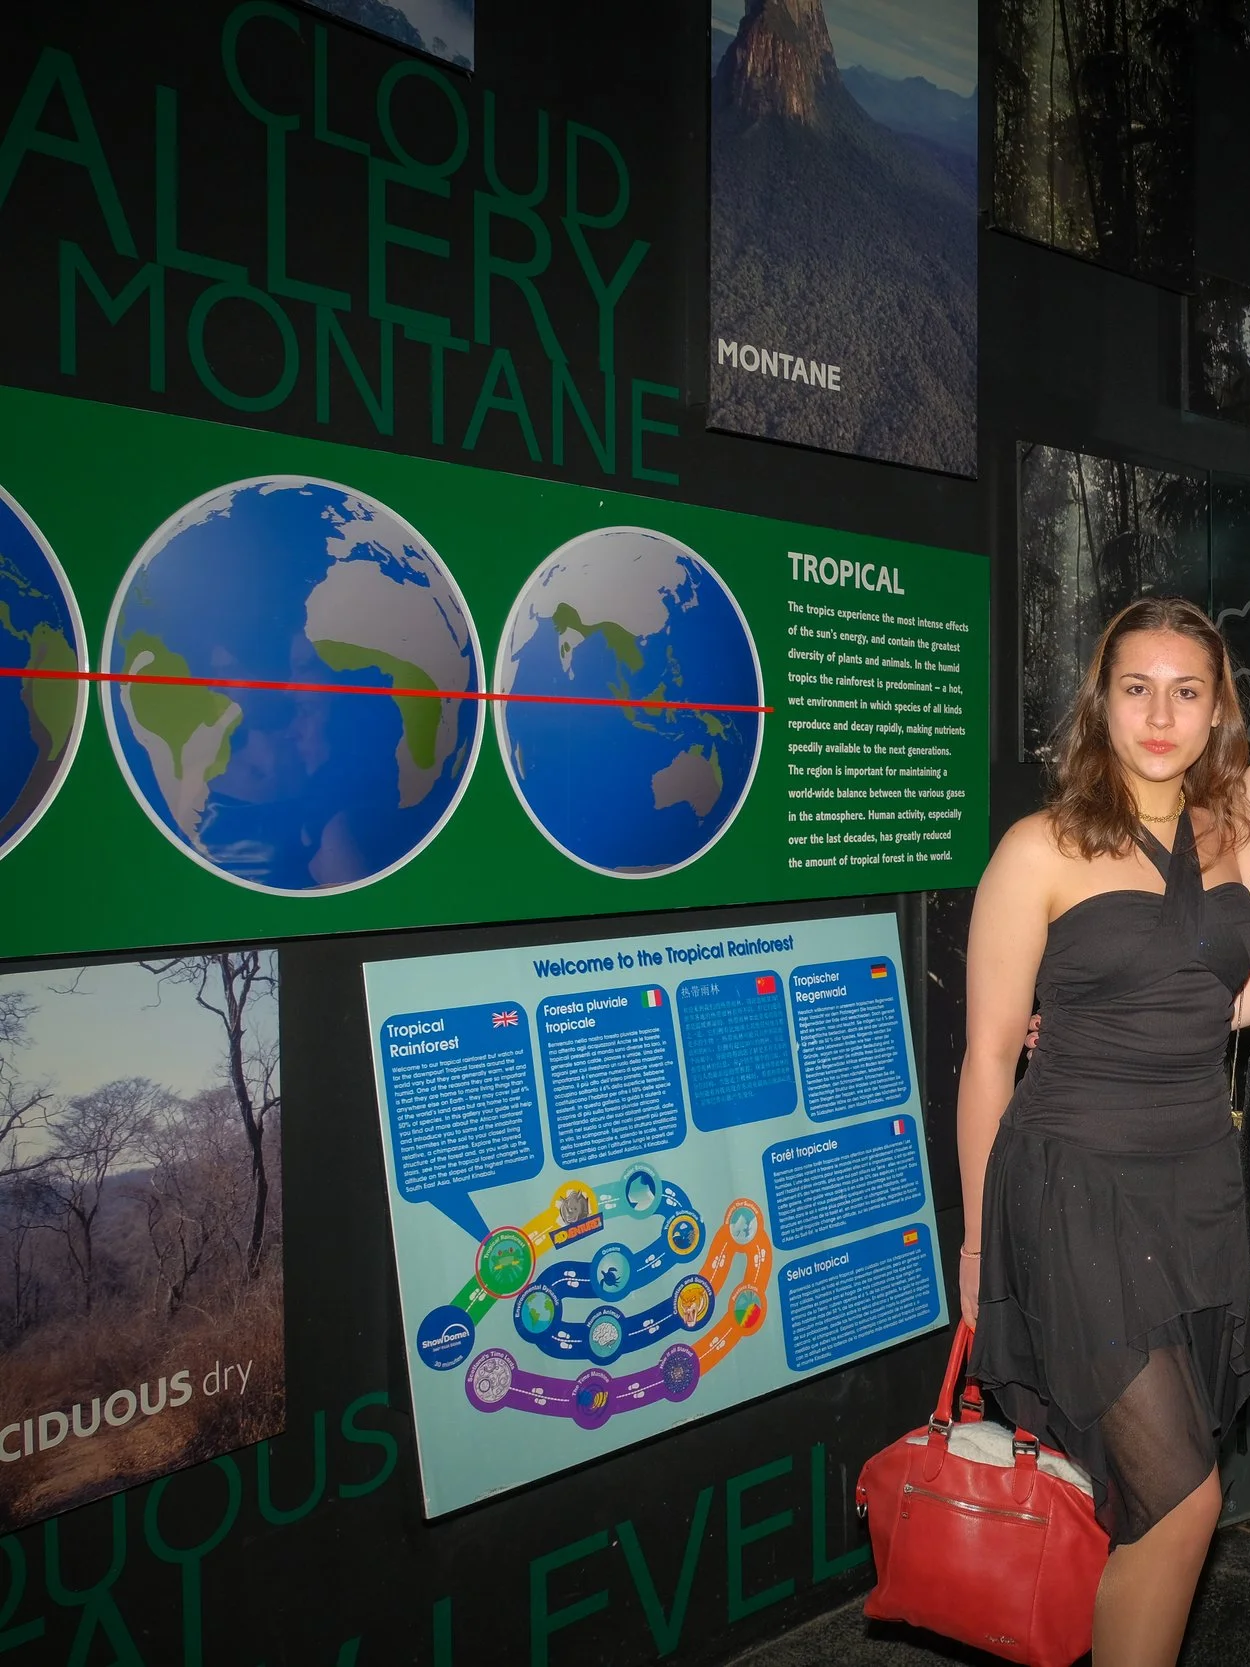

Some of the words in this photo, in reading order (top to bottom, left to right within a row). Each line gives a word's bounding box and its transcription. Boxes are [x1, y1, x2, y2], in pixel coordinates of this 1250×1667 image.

[220, 1, 630, 229] CLOUD
[58, 238, 681, 486] MONTANE
[717, 338, 841, 391] MONTANE
[788, 551, 905, 595] TROPICAL
[788, 600, 803, 612] The
[806, 604, 834, 617] tropics
[837, 610, 879, 621] experience
[882, 613, 894, 623] the
[897, 617, 915, 626] most
[918, 617, 943, 629] intense
[945, 620, 968, 632] effects
[788, 625, 797, 635] of
[800, 626, 813, 637] the
[816, 628, 837, 639] sun's
[840, 632, 868, 645] energy,
[871, 634, 885, 644] and
[888, 637, 914, 647] contain
[917, 638, 929, 648] the
[931, 641, 960, 652] greatest
[788, 648, 824, 663] diversity
[826, 651, 835, 661] of
[838, 653, 862, 665] plants
[865, 656, 879, 665] and
[882, 657, 912, 668] animals.
[915, 659, 922, 669] In
[924, 660, 936, 670] the
[938, 661, 959, 672] humid
[788, 671, 817, 685] tropics
[820, 674, 833, 684] the
[836, 675, 874, 687] rainforest
[877, 678, 883, 688] is
[886, 680, 932, 691] predominant
[949, 684, 962, 694] hot,
[788, 696, 804, 705] wet
[806, 696, 858, 708] environment
[860, 699, 867, 708] in
[870, 700, 892, 710] which
[894, 702, 920, 713] species
[922, 703, 931, 712] of
[933, 704, 941, 713] all
[944, 704, 962, 714] kinds
[788, 719, 830, 731] reproduce
[833, 720, 848, 730] and
[850, 721, 873, 734] decay
[876, 722, 903, 735] rapidly,
[906, 724, 932, 736] making
[934, 725, 965, 735] nutrients
[788, 742, 822, 755] speedily
[825, 743, 860, 753] available
[863, 744, 871, 753] to
[874, 744, 886, 754] the
[889, 745, 905, 754] next
[907, 746, 951, 757] generations.
[788, 764, 804, 775] The
[806, 765, 832, 778] region
[835, 765, 842, 775] is
[844, 765, 883, 778] important
[885, 766, 896, 776] for
[899, 767, 941, 779] maintaining
[788, 788, 834, 798] world-wide
[837, 787, 866, 797] balance
[869, 788, 901, 797] between
[904, 788, 916, 797] the
[918, 788, 944, 797] various
[946, 789, 965, 799] gases
[788, 811, 796, 821] in
[799, 811, 812, 821] the
[815, 810, 865, 822] atmosphere.
[868, 810, 895, 819] Human
[897, 809, 925, 821] activity,
[928, 809, 961, 821] especially
[788, 836, 807, 844] over
[810, 833, 823, 844] the
[826, 833, 841, 843] last
[843, 832, 877, 842] decades,
[880, 832, 893, 841] has
[895, 831, 920, 843] greatly
[923, 830, 951, 839] reduced
[788, 857, 802, 868] the
[805, 856, 836, 867] amount
[839, 855, 848, 865] of
[850, 853, 879, 866] tropical
[882, 853, 904, 863] forest
[906, 853, 913, 861] in
[916, 852, 928, 861] the
[930, 851, 952, 860] world.
[533, 954, 614, 978] Welcome
[618, 951, 634, 969] to
[637, 950, 663, 966] the
[666, 942, 725, 965] Tropical
[728, 935, 794, 957] Rainforest
[793, 972, 840, 987] Tropischer
[681, 983, 721, 999] 热带雨林
[796, 986, 847, 1003] Regenwald
[544, 1002, 584, 1017] Foresta
[586, 996, 628, 1013] pluviale
[387, 1019, 445, 1038] Tropical
[545, 1017, 596, 1034] tropicale
[390, 1036, 460, 1058] Rainforest
[392, 1064, 421, 1073] Welcome
[440, 1058, 462, 1067] tropical
[488, 1052, 497, 1060] but
[771, 1148, 795, 1163] Forêt
[796, 1139, 838, 1157] tropicale
[484, 1235, 500, 1259] Tropical
[500, 1235, 526, 1248] Rainforest
[786, 1266, 813, 1282] Selva
[814, 1252, 849, 1272] tropical
[515, 1284, 541, 1318] Environmental
[586, 1311, 601, 1328] Human
[602, 1309, 621, 1319] Animal
[491, 1351, 505, 1359] Time
[202, 1360, 253, 1396] dry
